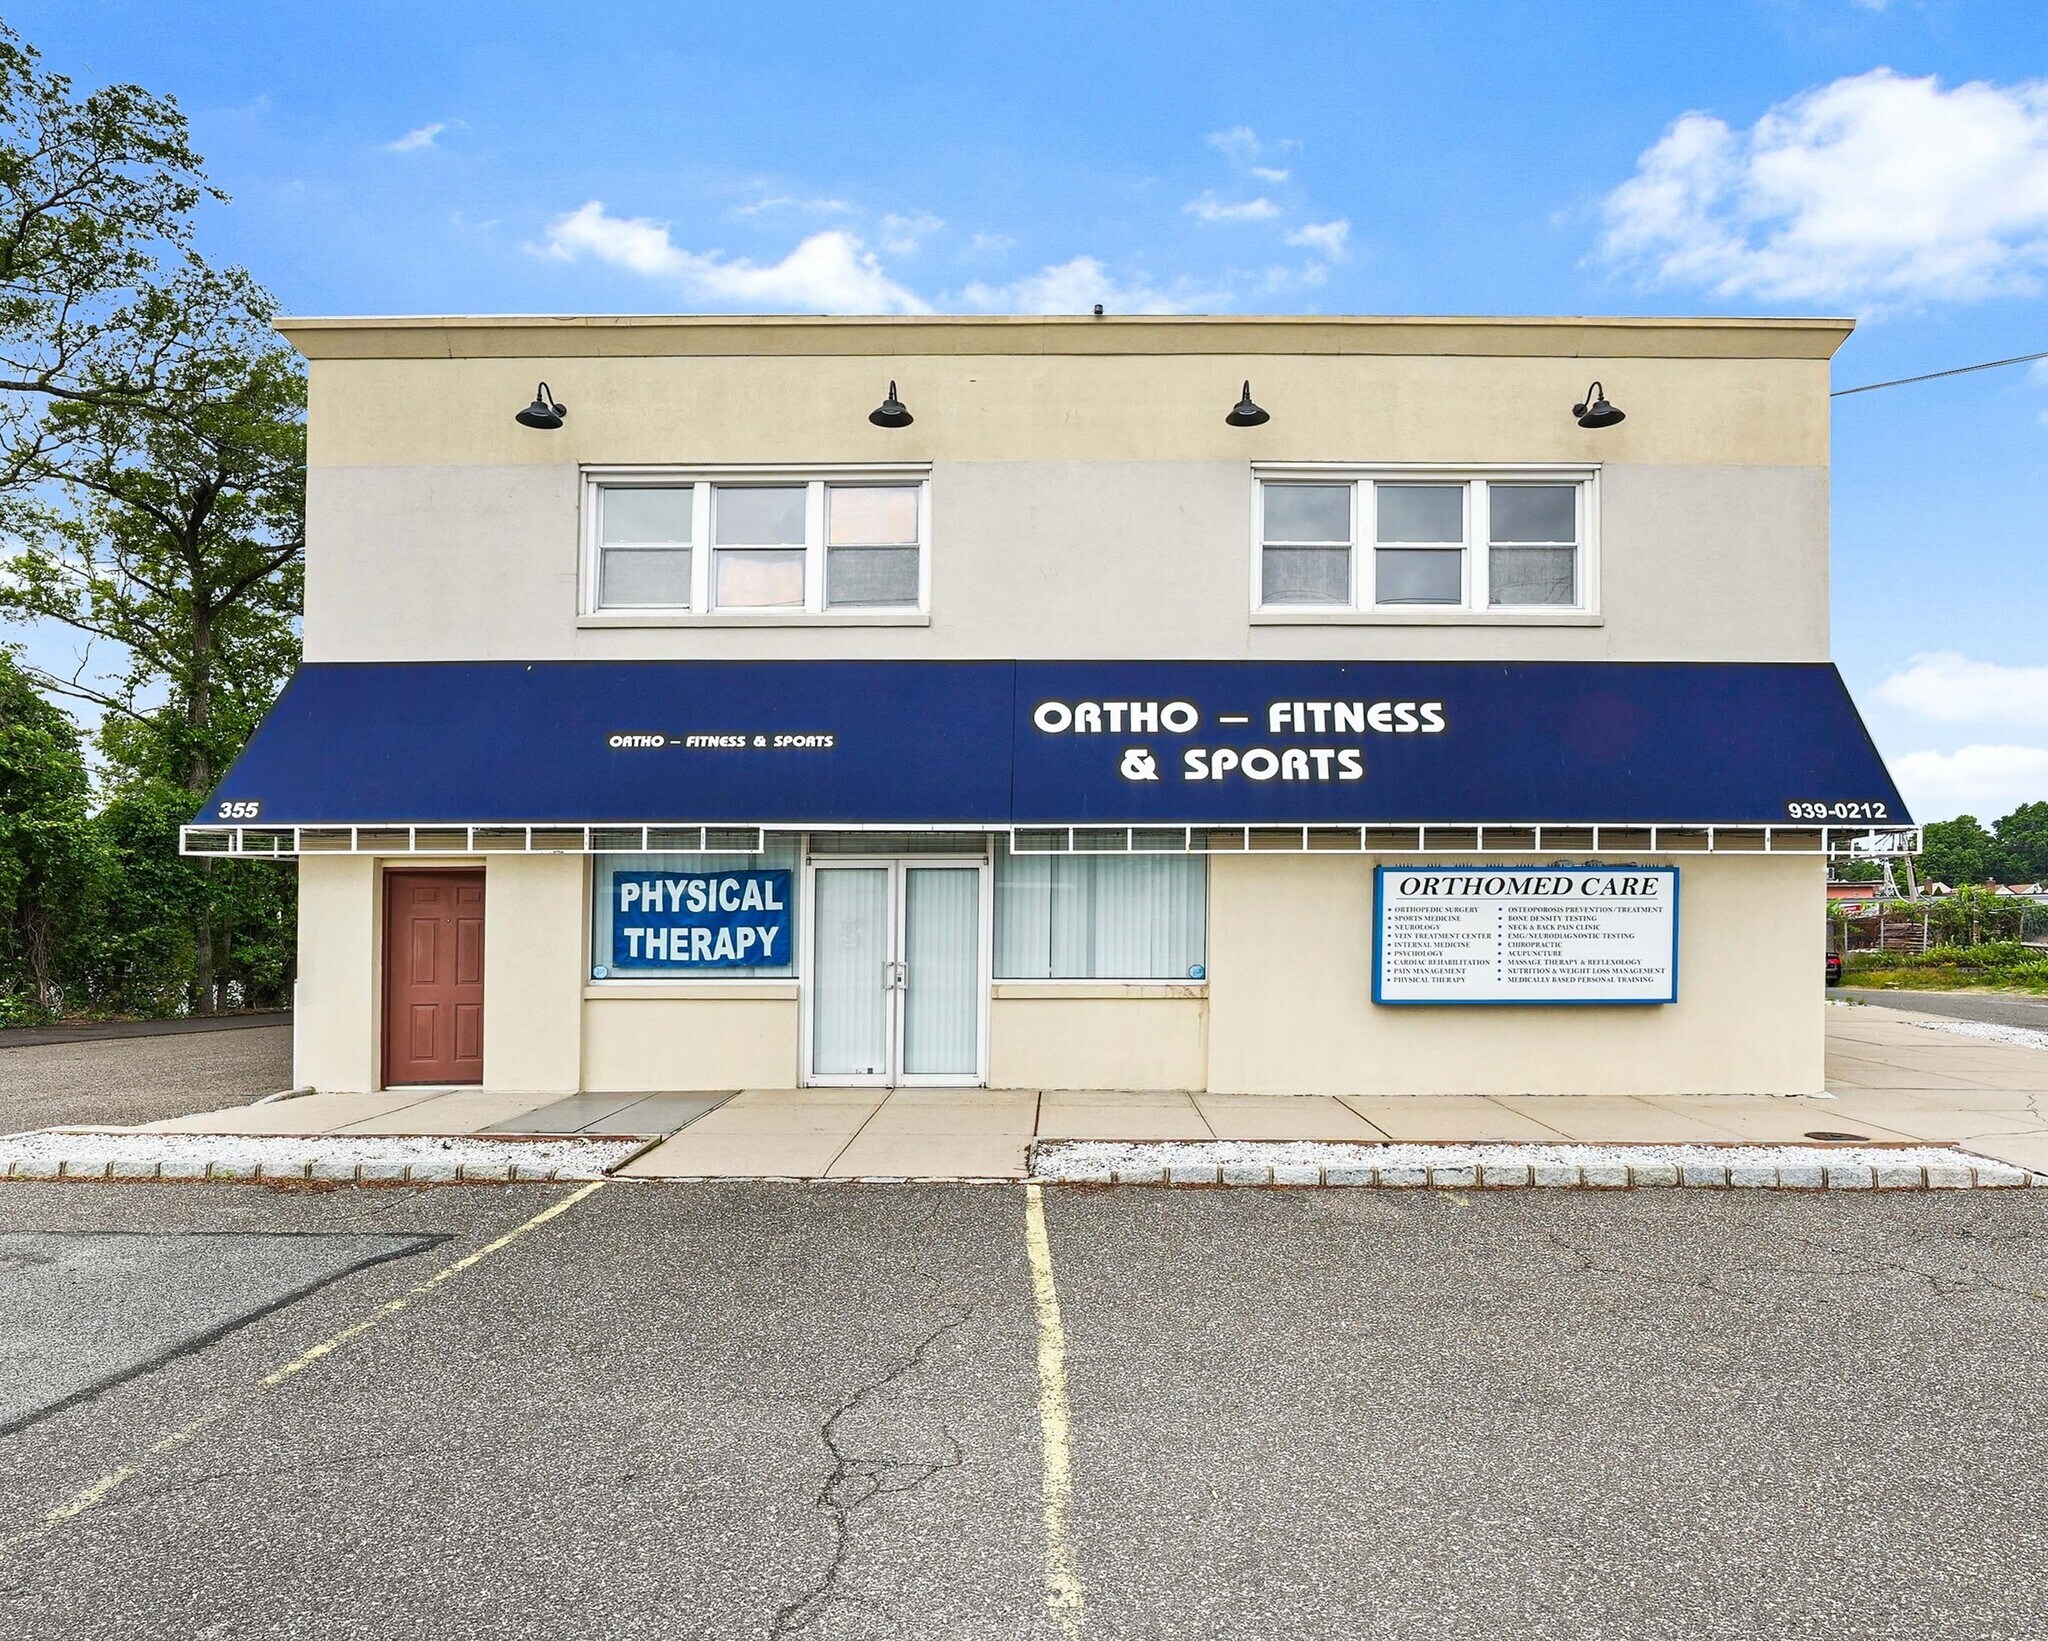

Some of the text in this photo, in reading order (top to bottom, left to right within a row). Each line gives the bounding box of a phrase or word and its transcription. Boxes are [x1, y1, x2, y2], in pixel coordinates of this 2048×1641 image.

[1034, 702, 1198, 732] ORTHO
[1270, 702, 1445, 732] FITNESS
[610, 736, 664, 747] ORTHO
[686, 736, 745, 747] FITNESS
[754, 736, 766, 747] &
[774, 736, 833, 747] SPORTS
[1121, 749, 1363, 780] & SPORTS
[219, 802, 259, 818] 355
[1789, 803, 1887, 818] 939-0212
[1400, 877, 1658, 895] ORTHOMED CARE
[621, 879, 783, 912] PHYSICAL
[624, 927, 778, 960] THERAPY
[1508, 932, 1635, 940] EMG/NEURODIAGNOSTIC TESTING
[1508, 958, 1642, 966] MASSAGE THERAPY & REFLEXOLOGY
